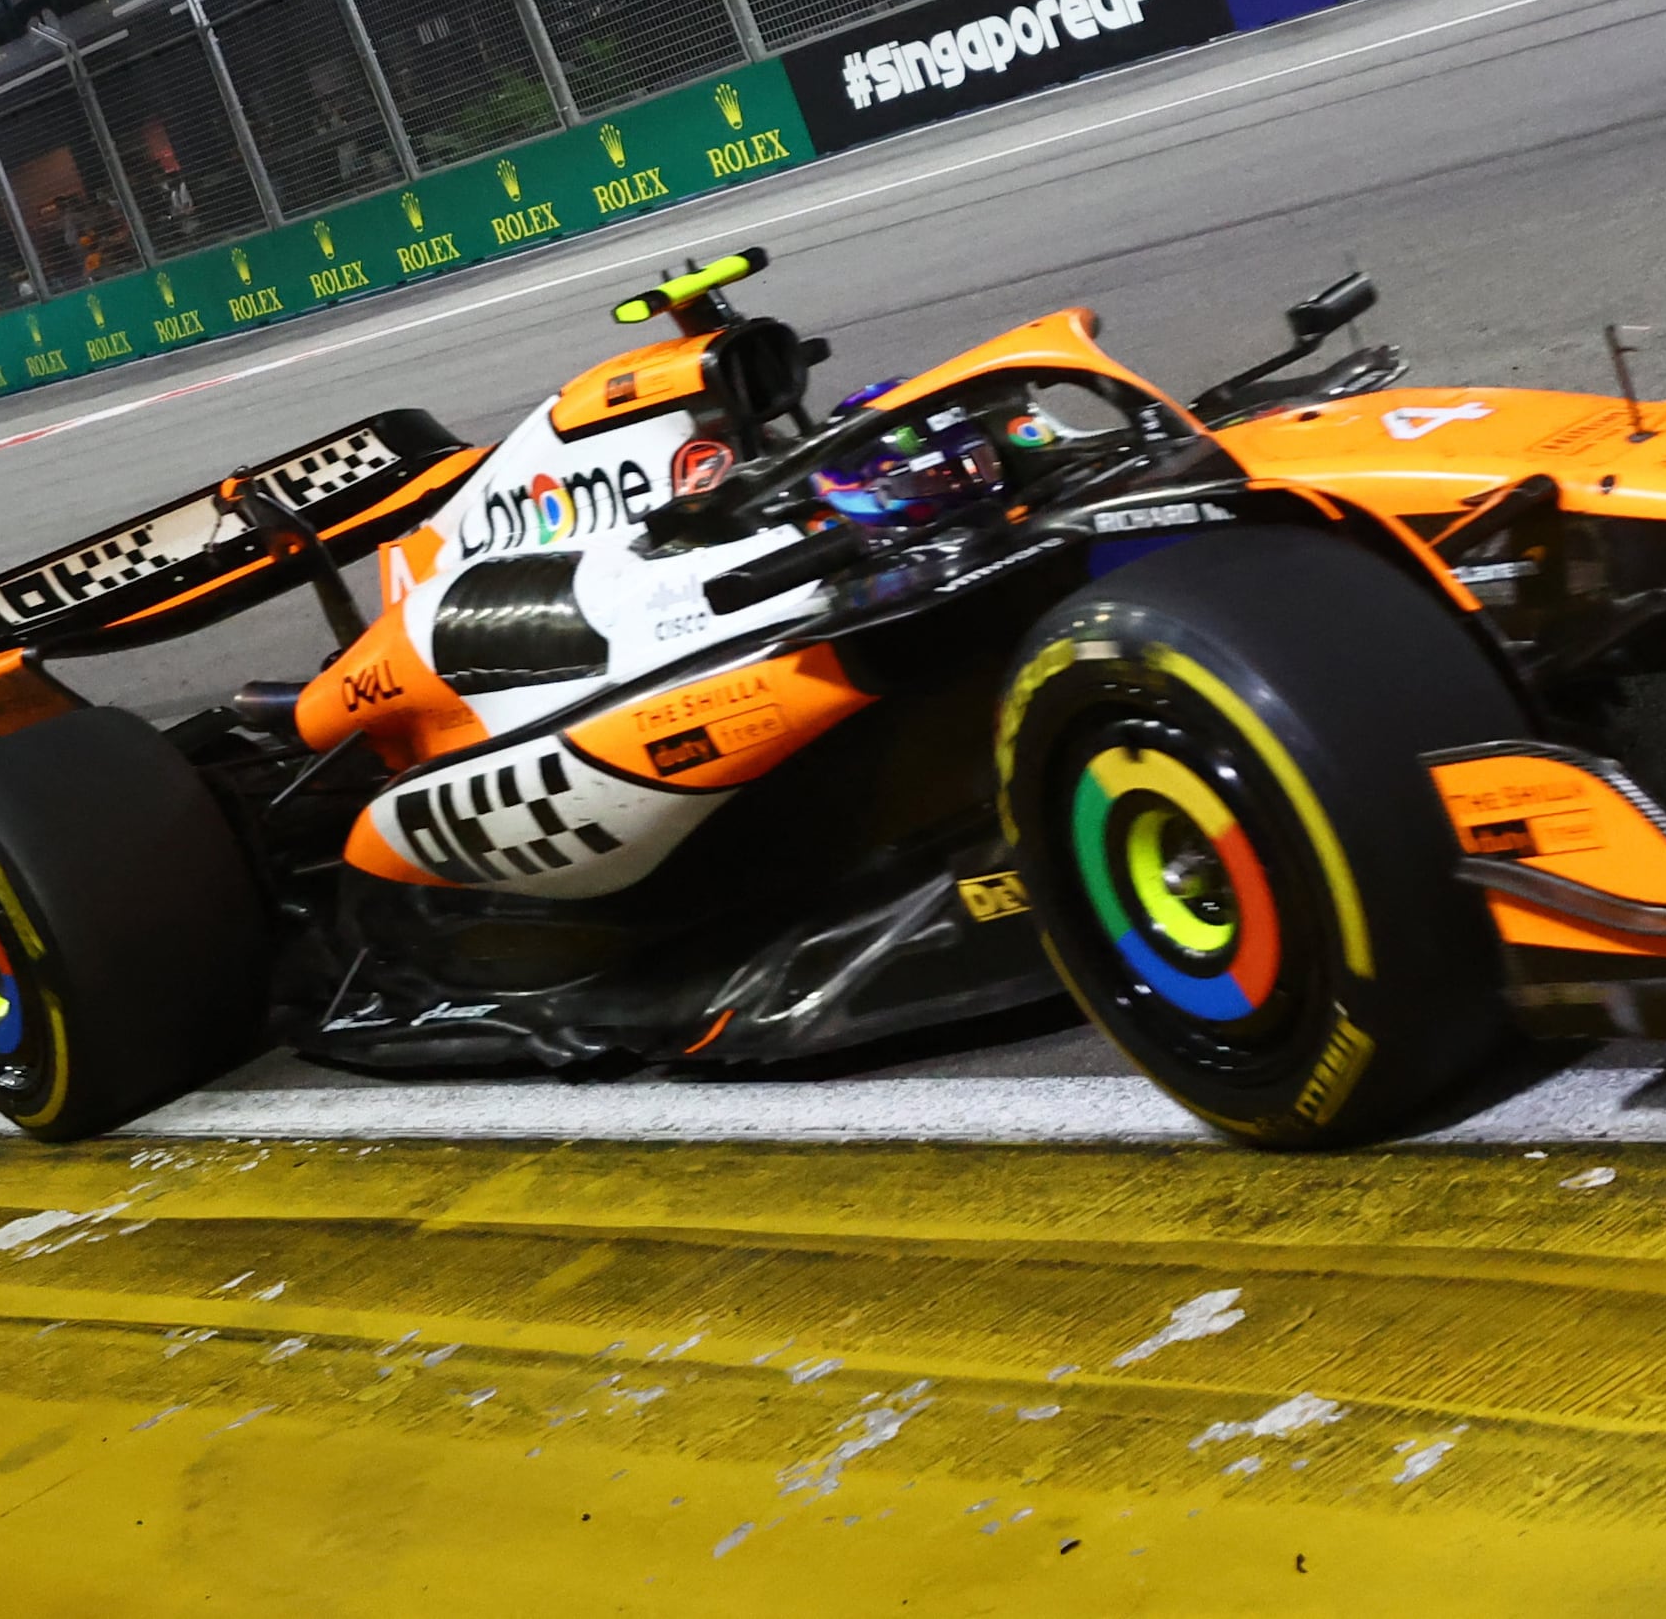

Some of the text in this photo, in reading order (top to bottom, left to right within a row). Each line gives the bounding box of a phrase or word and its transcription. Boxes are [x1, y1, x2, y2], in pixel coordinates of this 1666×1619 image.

[706, 129, 790, 178] ROLEX
[592, 167, 669, 214] ROLEX
[491, 202, 561, 245] ROLEX
[396, 233, 461, 273] ROLEX
[309, 261, 370, 298] ROLEX
[229, 286, 284, 323] ROLEX
[86, 331, 133, 362] ROLEX
[154, 310, 204, 343] ROLEX
[26, 349, 68, 378] ROLEX
[1381, 402, 1496, 439] 4
[458, 459, 653, 558] chrome
[342, 659, 404, 712] DELL
[396, 752, 624, 883] OKX
